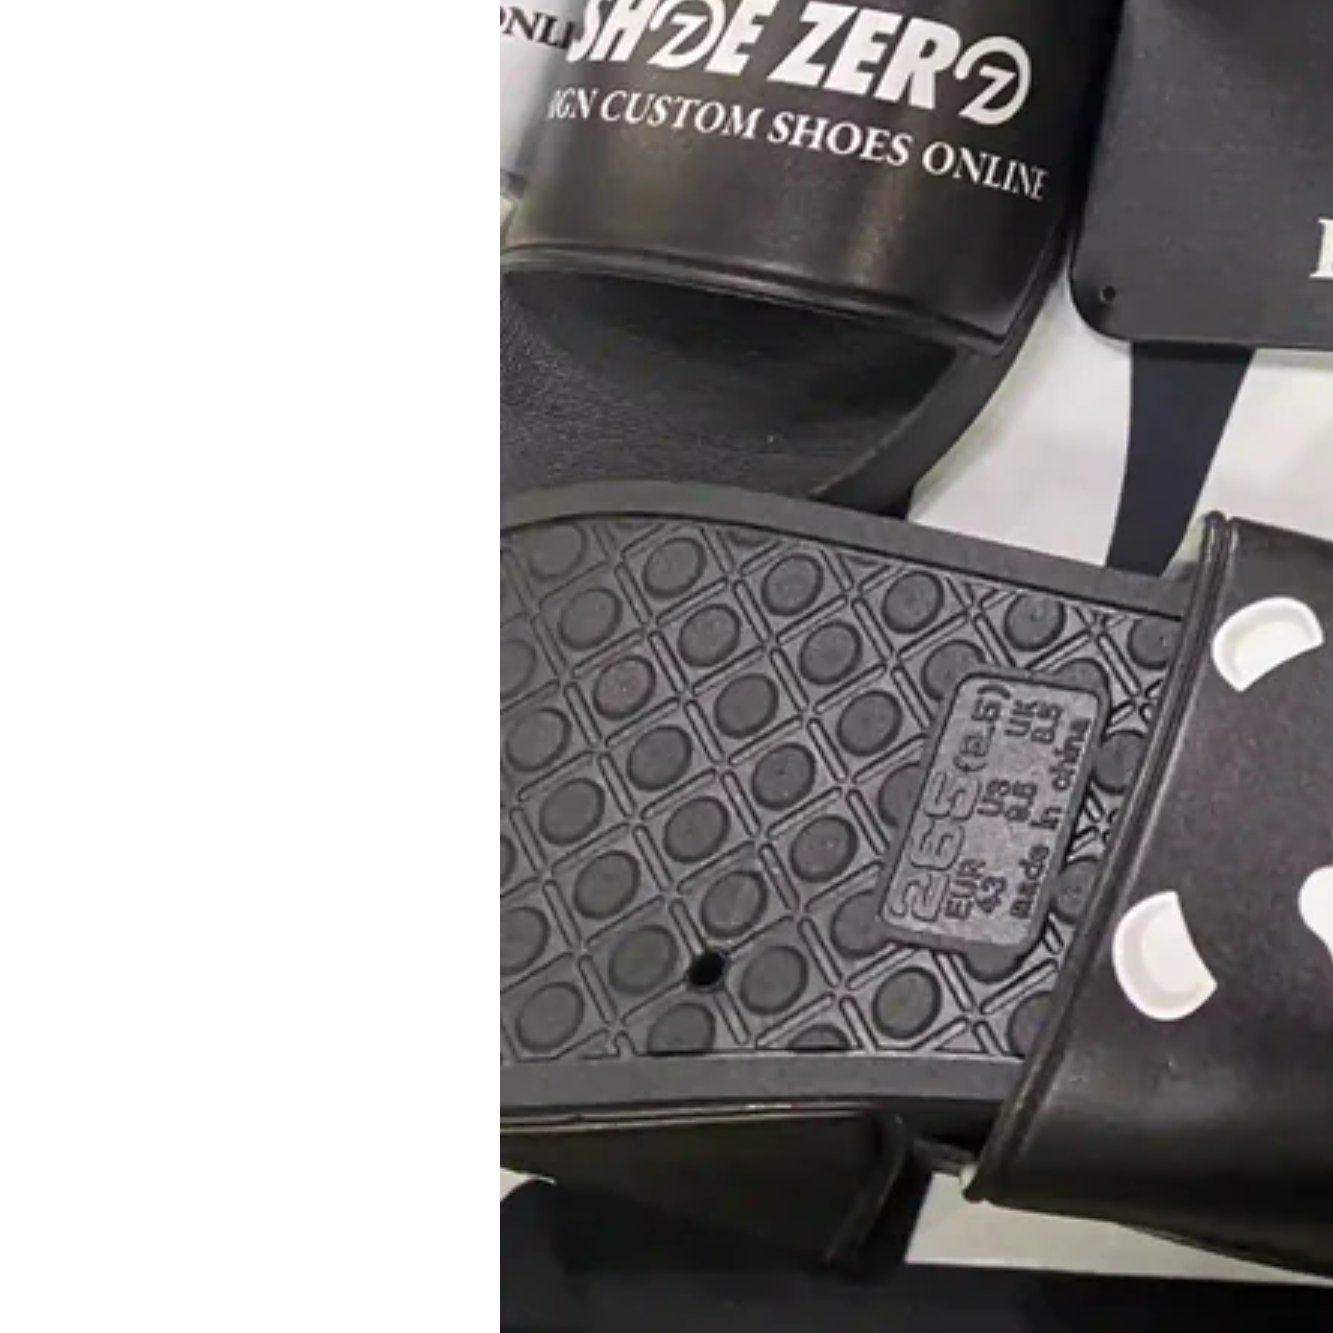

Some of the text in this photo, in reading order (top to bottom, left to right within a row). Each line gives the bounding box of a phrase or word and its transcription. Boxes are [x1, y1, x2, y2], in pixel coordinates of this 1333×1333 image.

[599, 89, 764, 141] CUSTOM
[766, 110, 914, 168] SHOES
[921, 140, 1050, 202] ONLINE
[943, 858, 987, 920] EUR
[1003, 698, 1040, 737] UK
